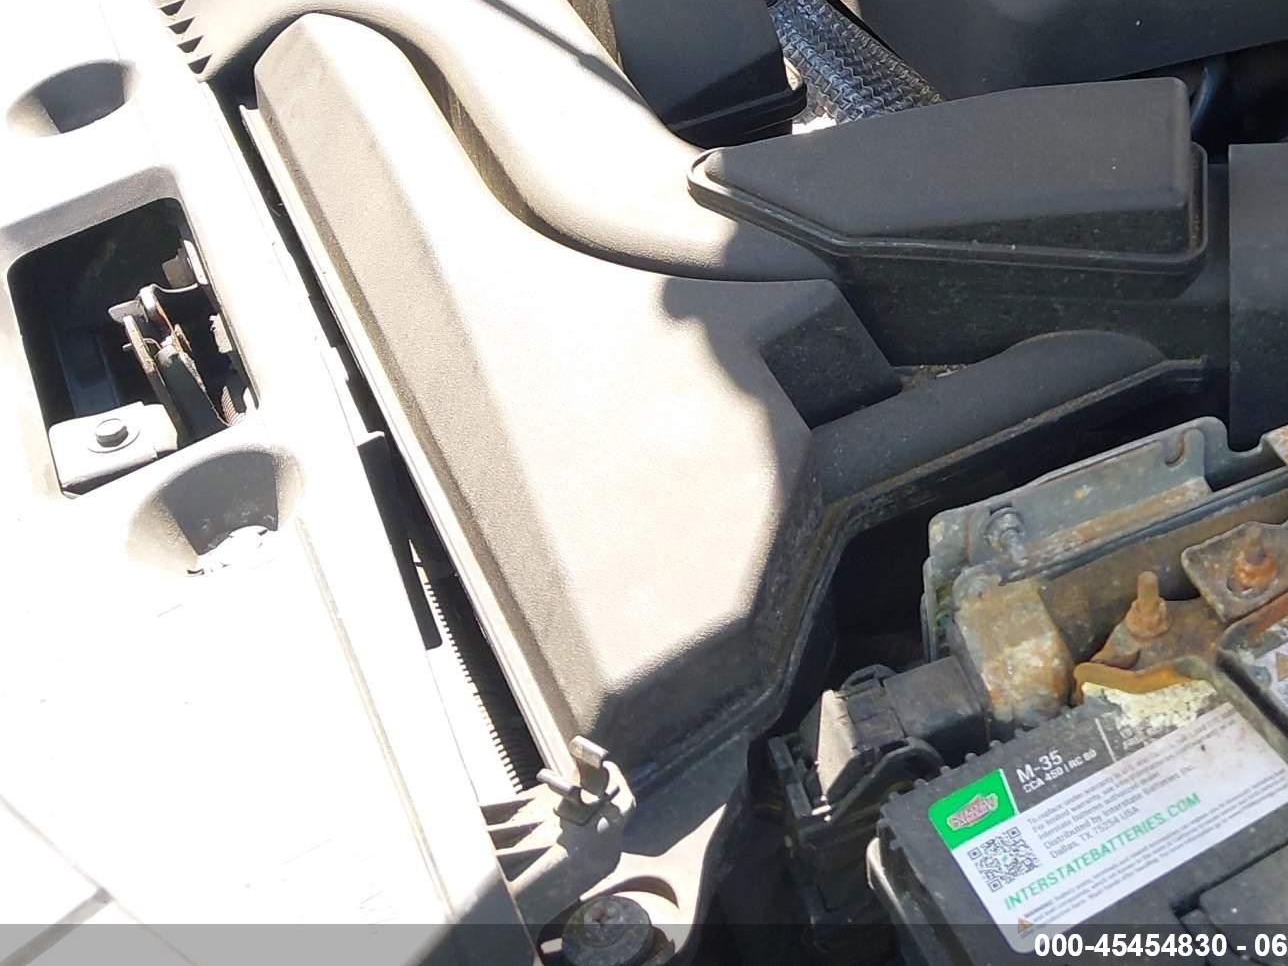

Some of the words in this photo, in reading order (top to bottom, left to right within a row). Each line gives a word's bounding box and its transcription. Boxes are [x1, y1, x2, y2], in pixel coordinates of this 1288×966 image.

[1014, 747, 1064, 784] M-35
[1021, 775, 1045, 794] CCA
[1043, 765, 1064, 782] 450
[1067, 754, 1083, 769] RC
[1042, 818, 1092, 850] Distributed
[1089, 812, 1103, 825] by
[1101, 790, 1143, 818] Interstate
[1141, 770, 1180, 795] Batteries
[1049, 837, 1080, 859] Dallas,
[1079, 829, 1094, 843] TX
[1092, 814, 1121, 835] 75254
[1119, 804, 1140, 821] USA
[1003, 791, 1202, 910] INTERSTATEBATTERIES.COM
